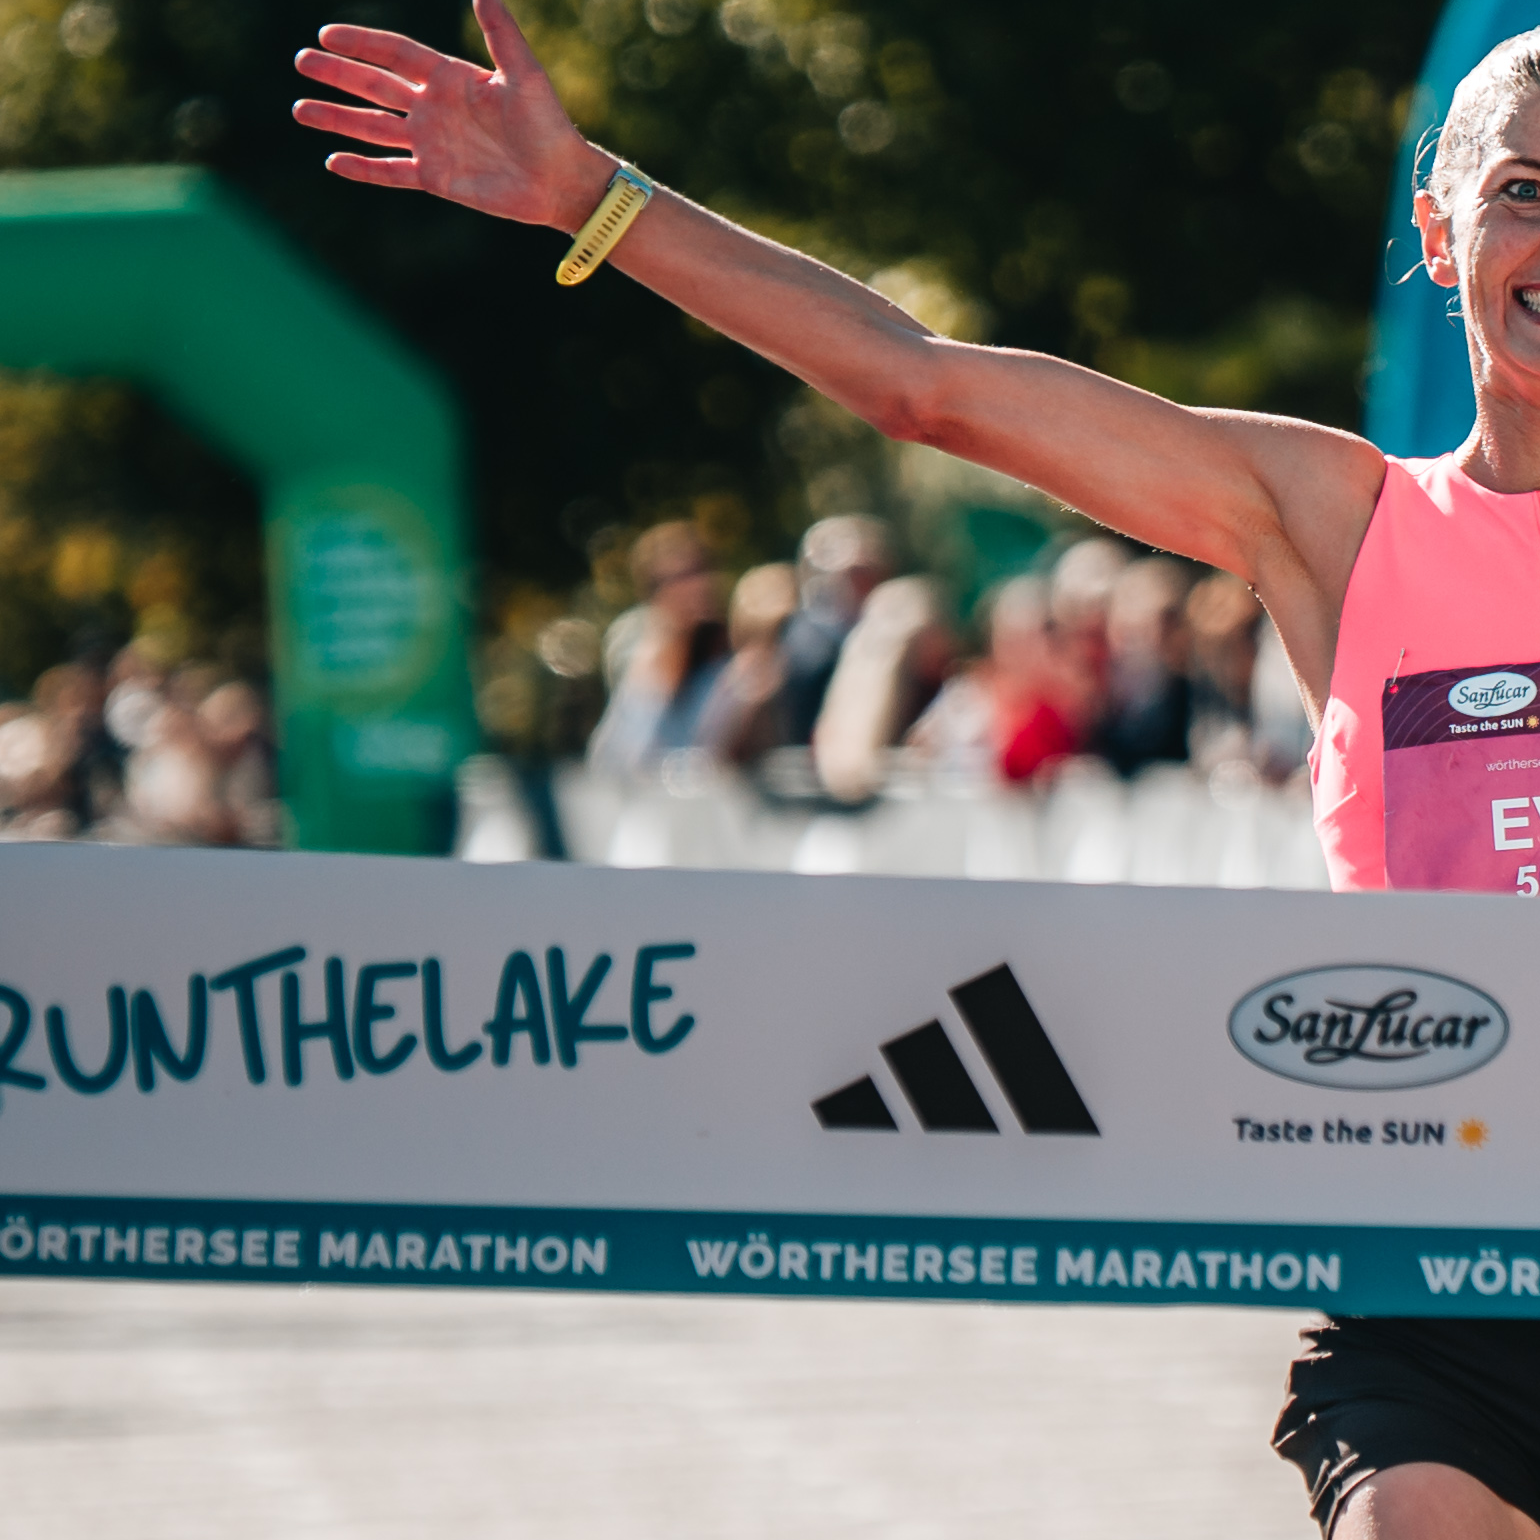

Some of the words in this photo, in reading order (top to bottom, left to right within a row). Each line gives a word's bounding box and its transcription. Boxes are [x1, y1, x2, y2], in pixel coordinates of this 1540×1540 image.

[1457, 680, 1530, 710] SanLucar
[1449, 722, 1478, 734] Taste
[1480, 721, 1498, 732] the
[1500, 718, 1523, 729] SUN
[1253, 989, 1491, 1065] SanLucar
[1232, 1117, 1313, 1143] Taste
[1323, 1118, 1373, 1144] the
[1382, 1120, 1446, 1146] SUN
[317, 1230, 609, 1276] MARATHON
[686, 1232, 1039, 1286] WÖRTHERSEE
[1055, 1247, 1342, 1293] MARATHON
